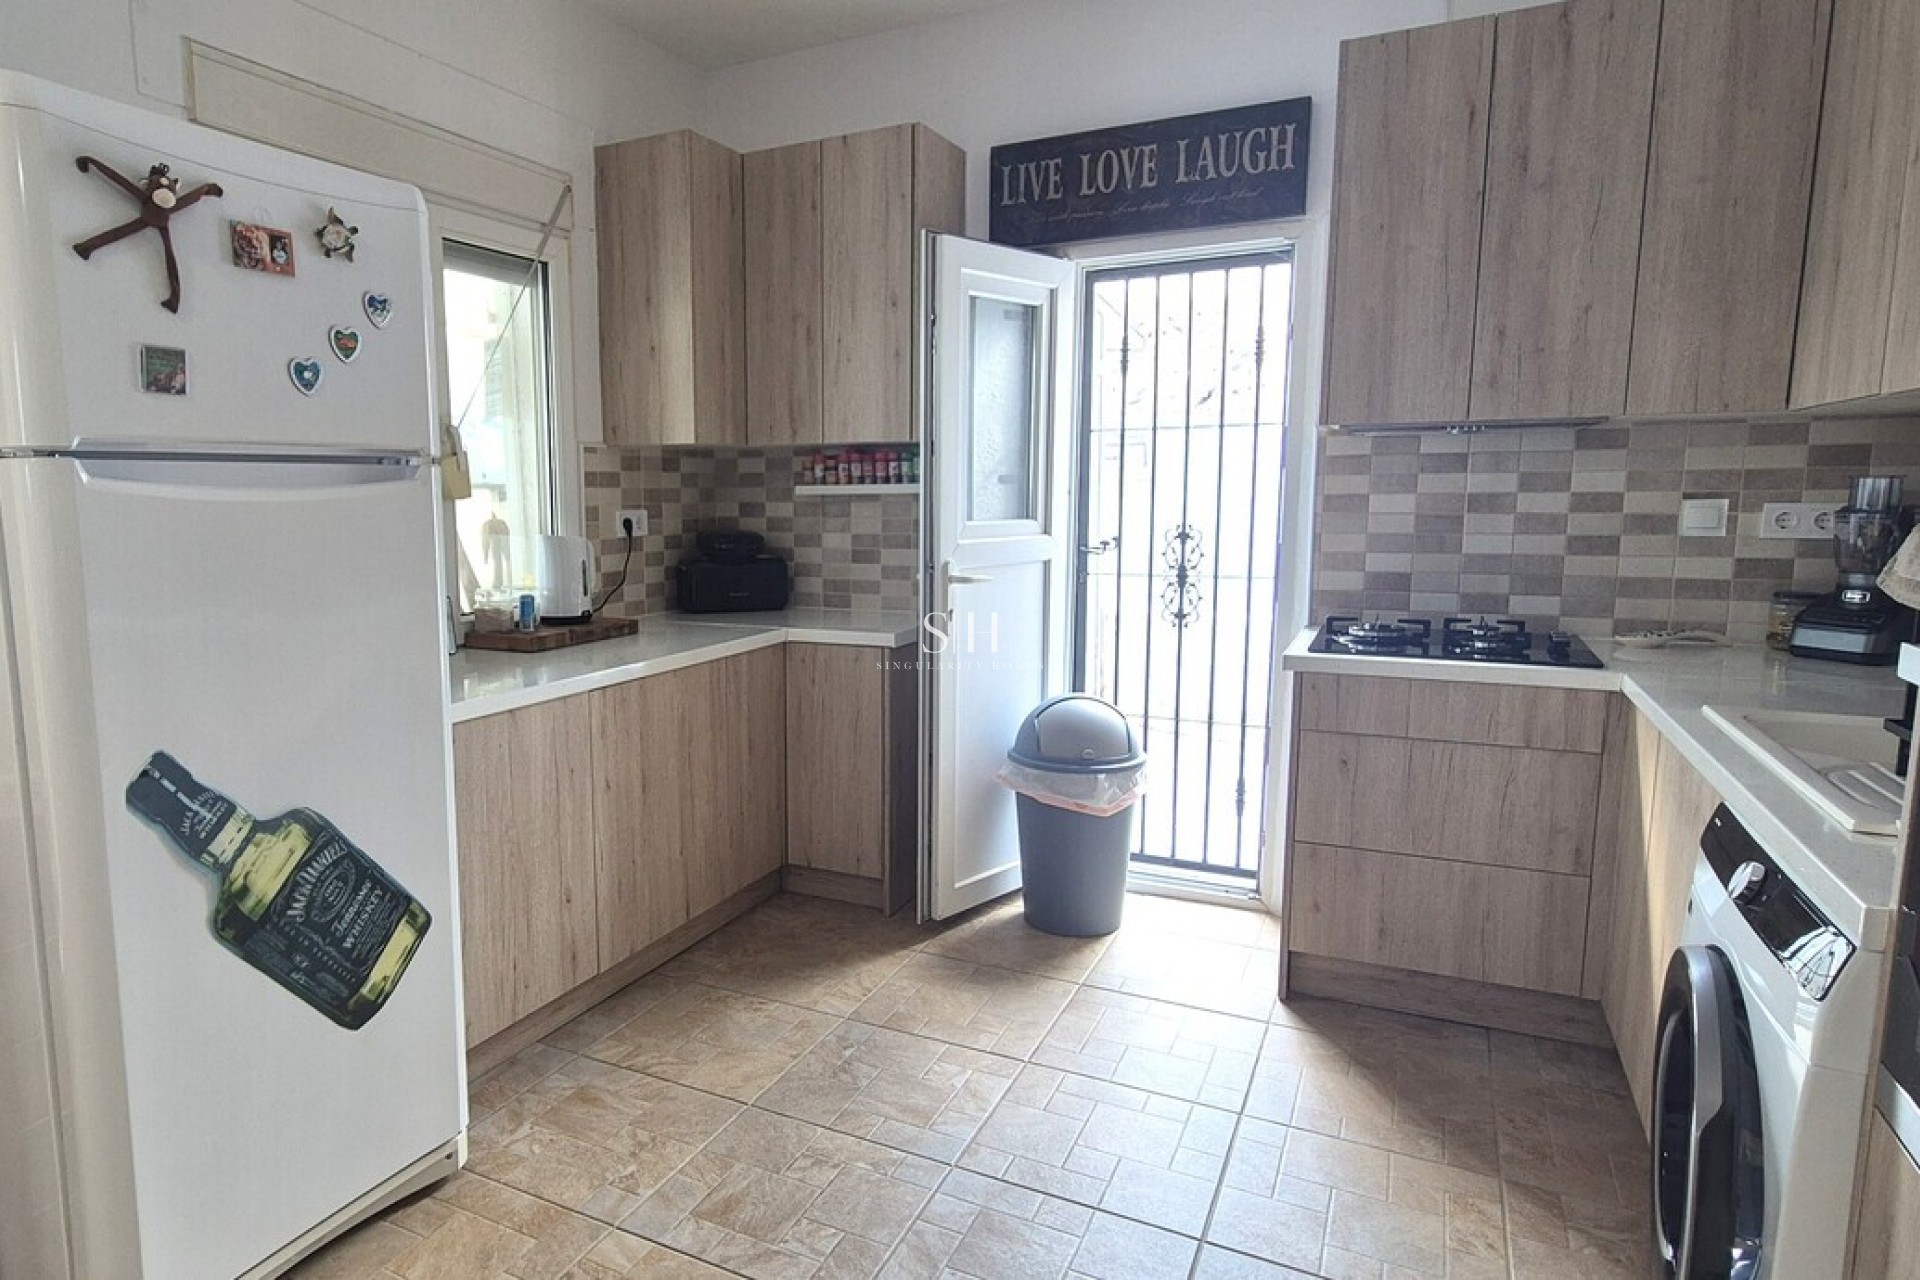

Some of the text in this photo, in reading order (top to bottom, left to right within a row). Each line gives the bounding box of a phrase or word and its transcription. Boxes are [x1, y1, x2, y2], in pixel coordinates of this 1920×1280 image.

[1001, 123, 1297, 206] LIVE LOVE LAUGH
